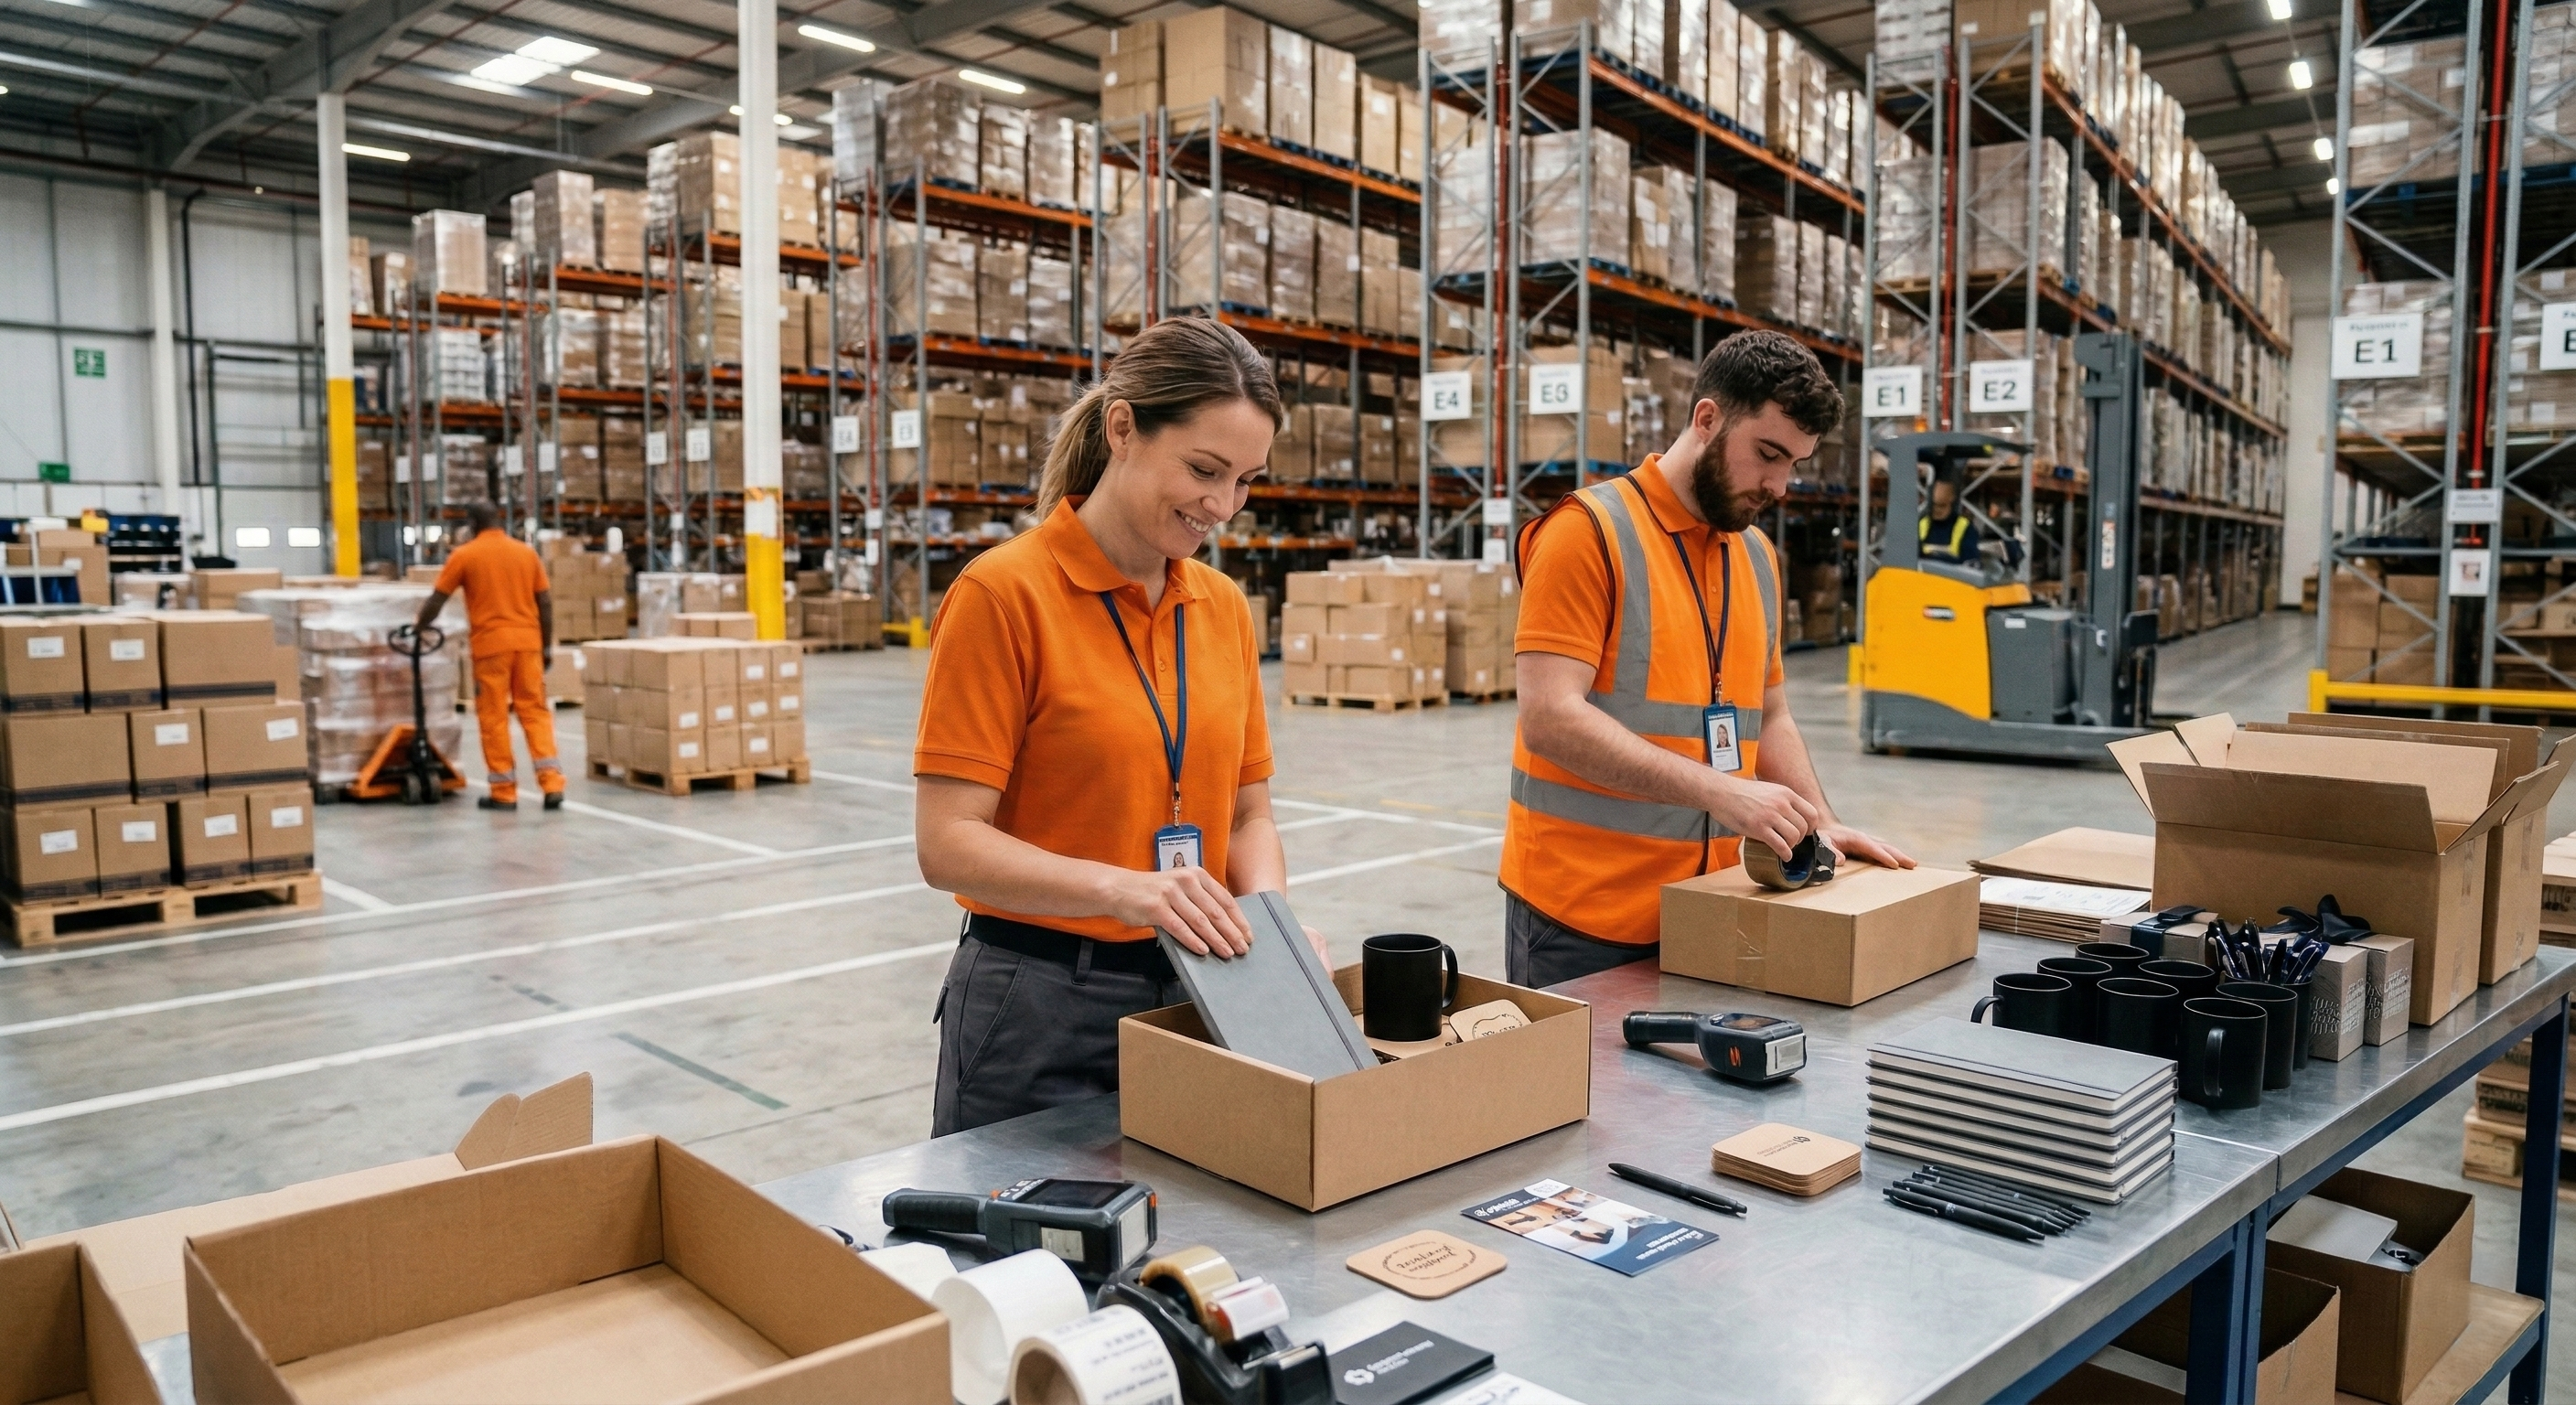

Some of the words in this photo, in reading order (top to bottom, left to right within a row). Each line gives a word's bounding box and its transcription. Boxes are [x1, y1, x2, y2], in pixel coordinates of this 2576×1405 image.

[2355, 338, 2398, 364] E1
[1433, 390, 1459, 411] E4
[1540, 382, 1569, 404] E3
[1877, 384, 1905, 408] E1
[1983, 379, 2017, 402] E2
